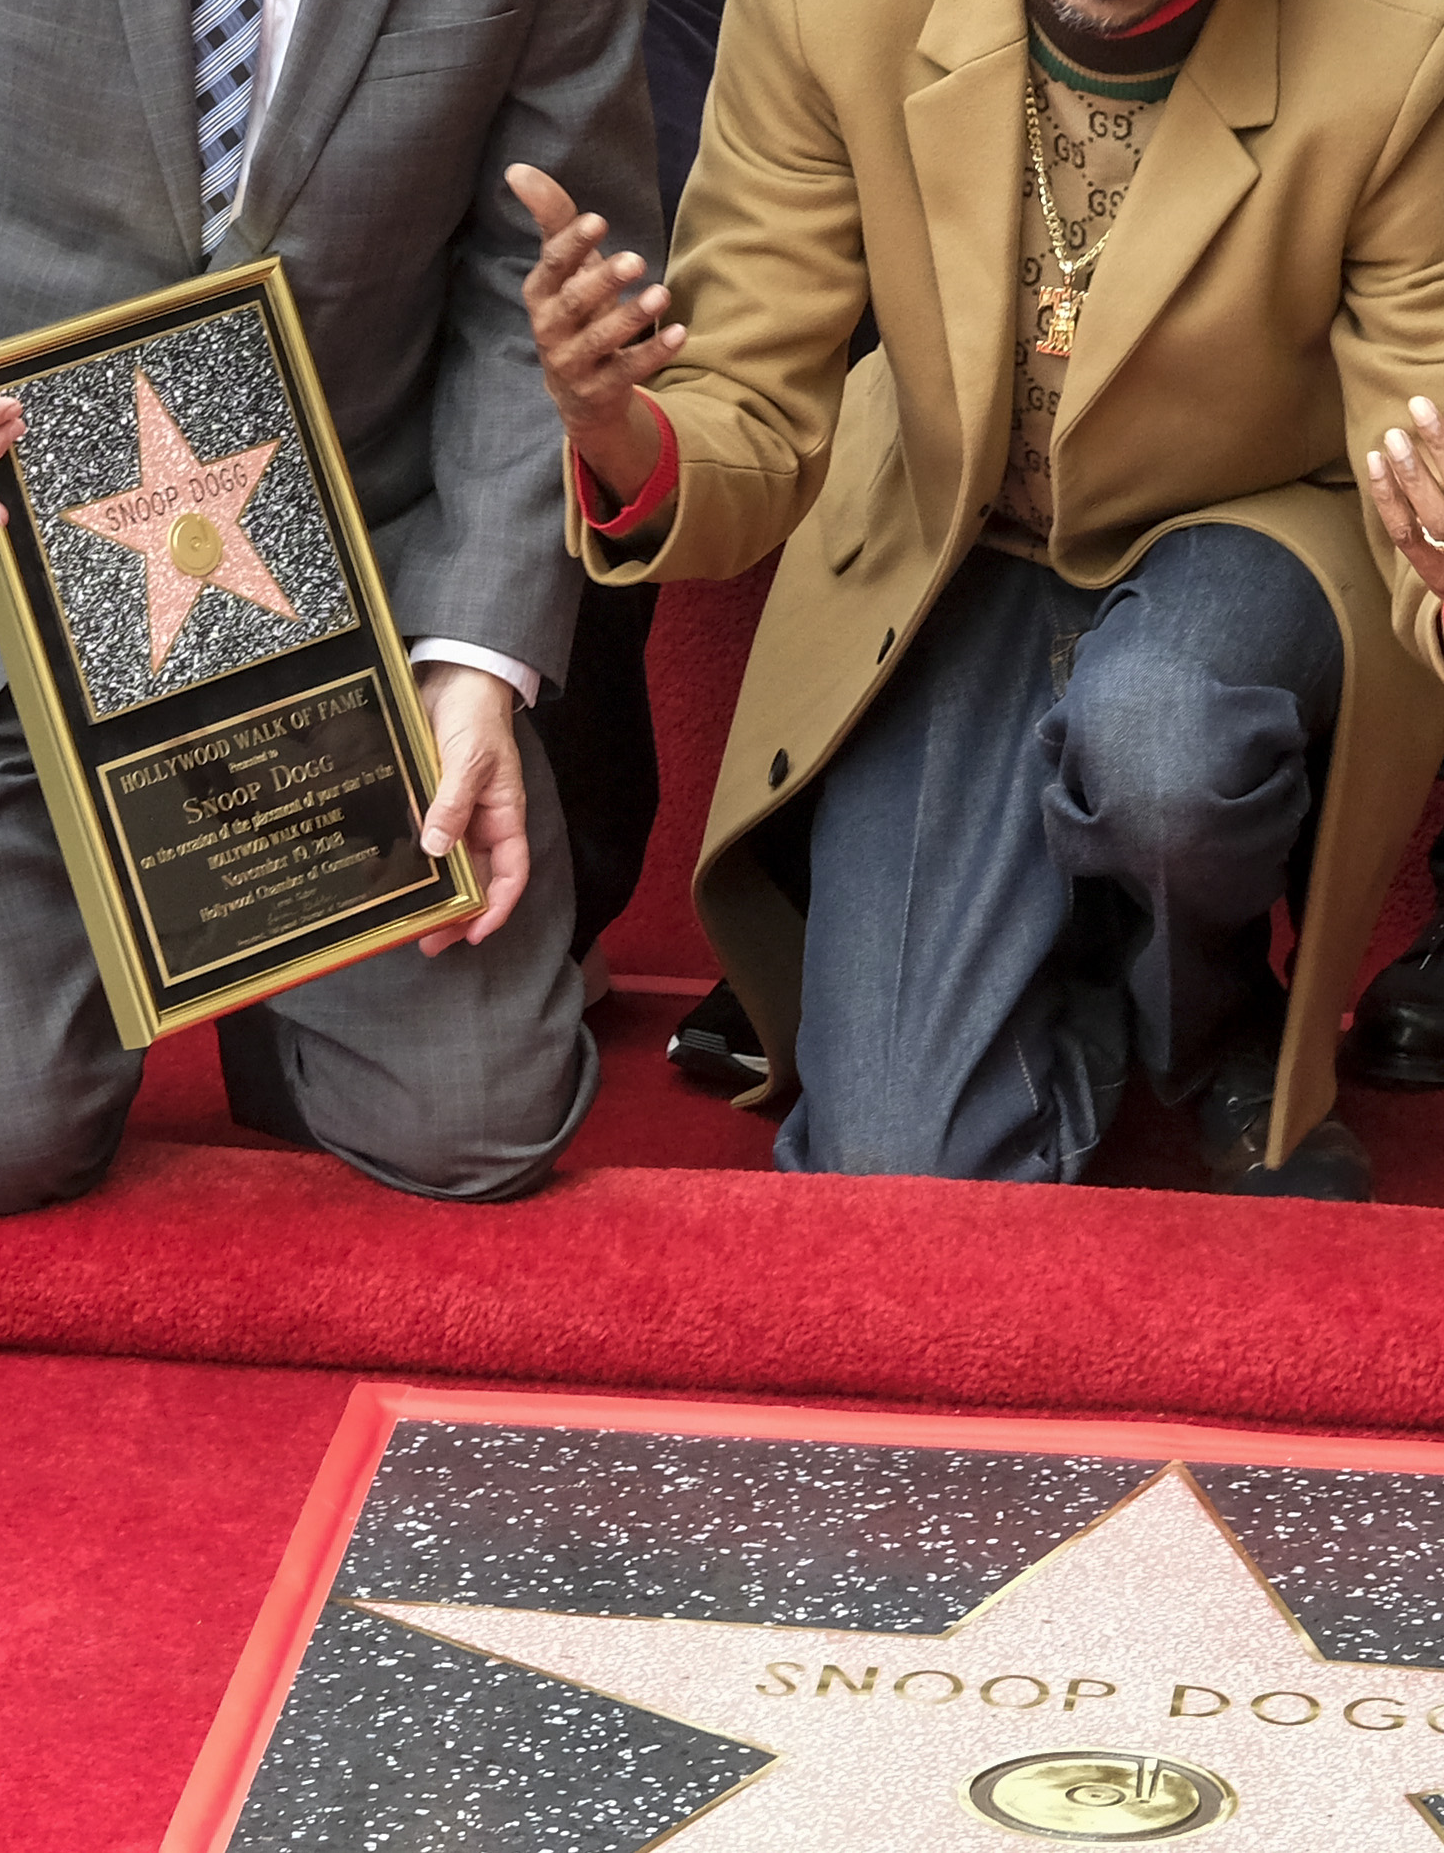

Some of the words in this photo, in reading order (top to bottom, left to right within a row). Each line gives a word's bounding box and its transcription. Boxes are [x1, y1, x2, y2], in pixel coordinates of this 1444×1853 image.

[106, 486, 178, 532] SNOOP
[189, 463, 248, 504] DOGG
[120, 738, 232, 794] HOLLYWOOD
[232, 717, 287, 750] WALK
[290, 707, 312, 729] OF
[317, 687, 368, 721] FAME
[156, 847, 176, 864] the
[231, 819, 252, 836] the
[207, 836, 270, 870] HOLLYWOOD
[268, 824, 301, 847] WALK
[300, 818, 313, 834] OF
[314, 807, 345, 829] FAME
[221, 855, 288, 890] November
[310, 831, 345, 857] 2018
[199, 891, 255, 922] Hollywood
[256, 874, 305, 899] Chamber
[307, 865, 319, 881] of
[321, 846, 380, 875] Commerce
[755, 1661, 1116, 1713] SNOOP
